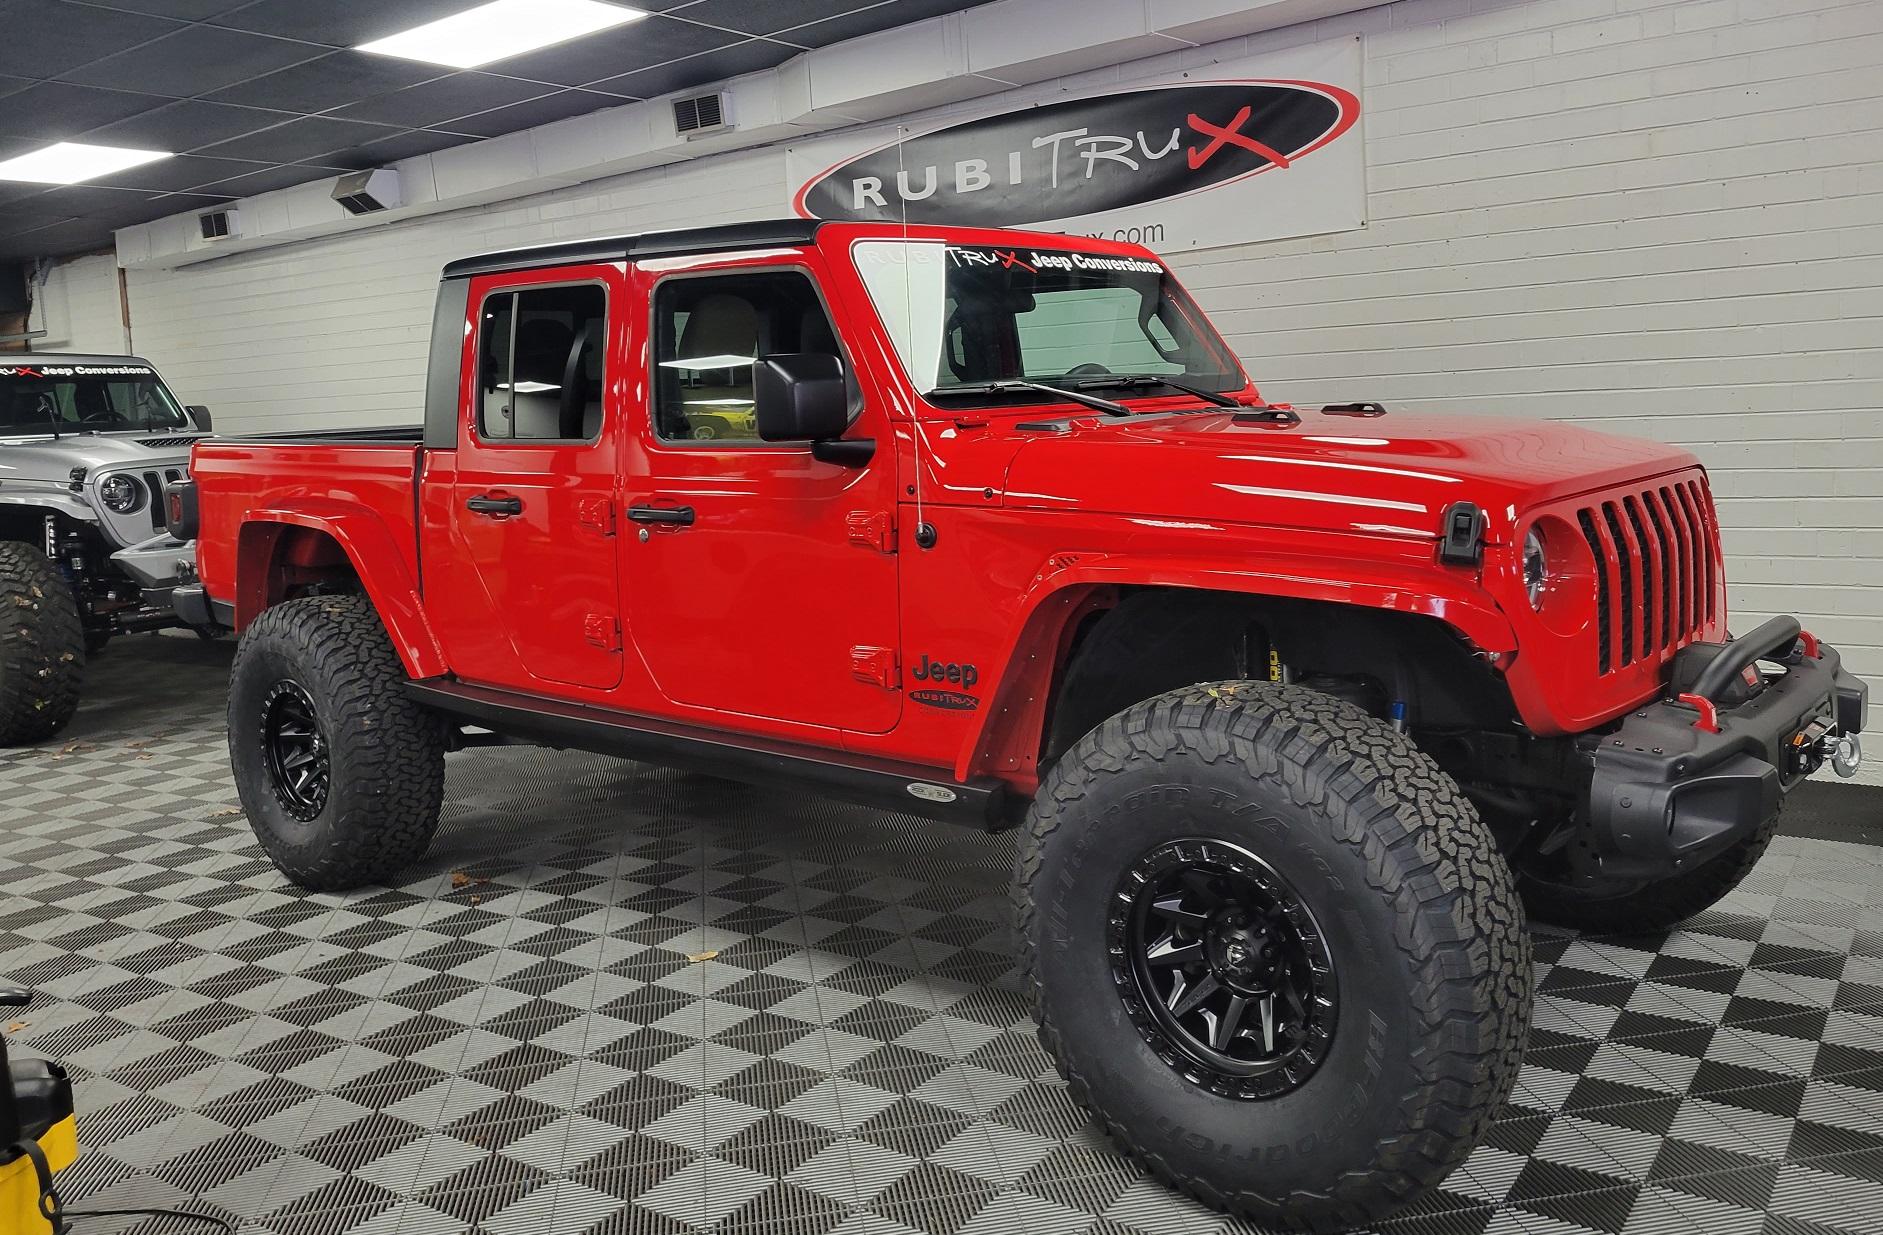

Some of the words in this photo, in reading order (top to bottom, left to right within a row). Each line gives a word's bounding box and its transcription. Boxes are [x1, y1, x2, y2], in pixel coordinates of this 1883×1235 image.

[1030, 251, 1072, 270] Jeep
[1071, 252, 1164, 274] Conversions
[41, 366, 74, 376] Jeep
[74, 365, 151, 376] Conversions
[912, 653, 978, 690] Jeep
[1208, 786, 1291, 838] T/A
